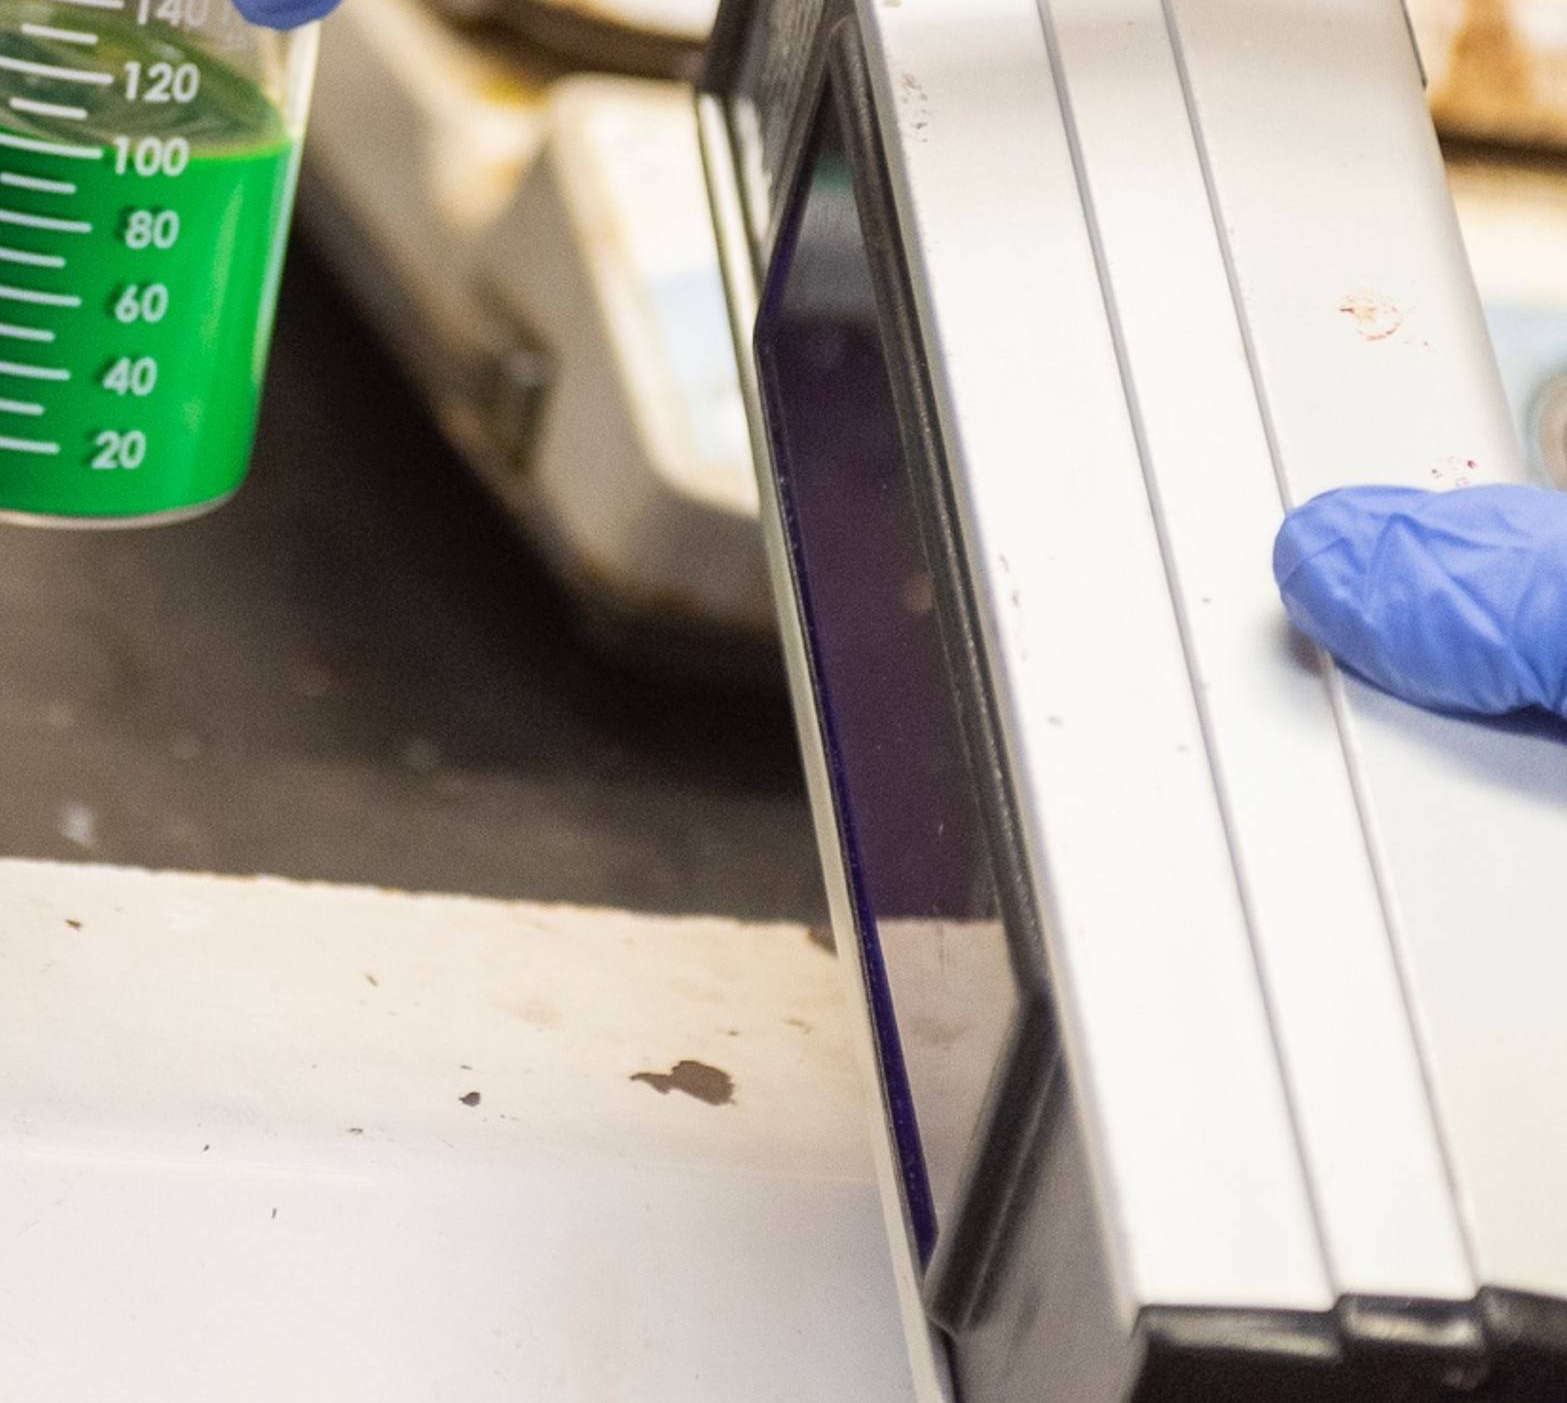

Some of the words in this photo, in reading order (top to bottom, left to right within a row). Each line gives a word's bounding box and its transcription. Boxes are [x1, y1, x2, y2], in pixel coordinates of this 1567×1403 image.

[124, 61, 200, 103] 120
[113, 136, 189, 177] 100
[125, 210, 180, 249] 80
[115, 283, 169, 323] 60
[103, 357, 158, 396] 40
[91, 430, 146, 469] 20
